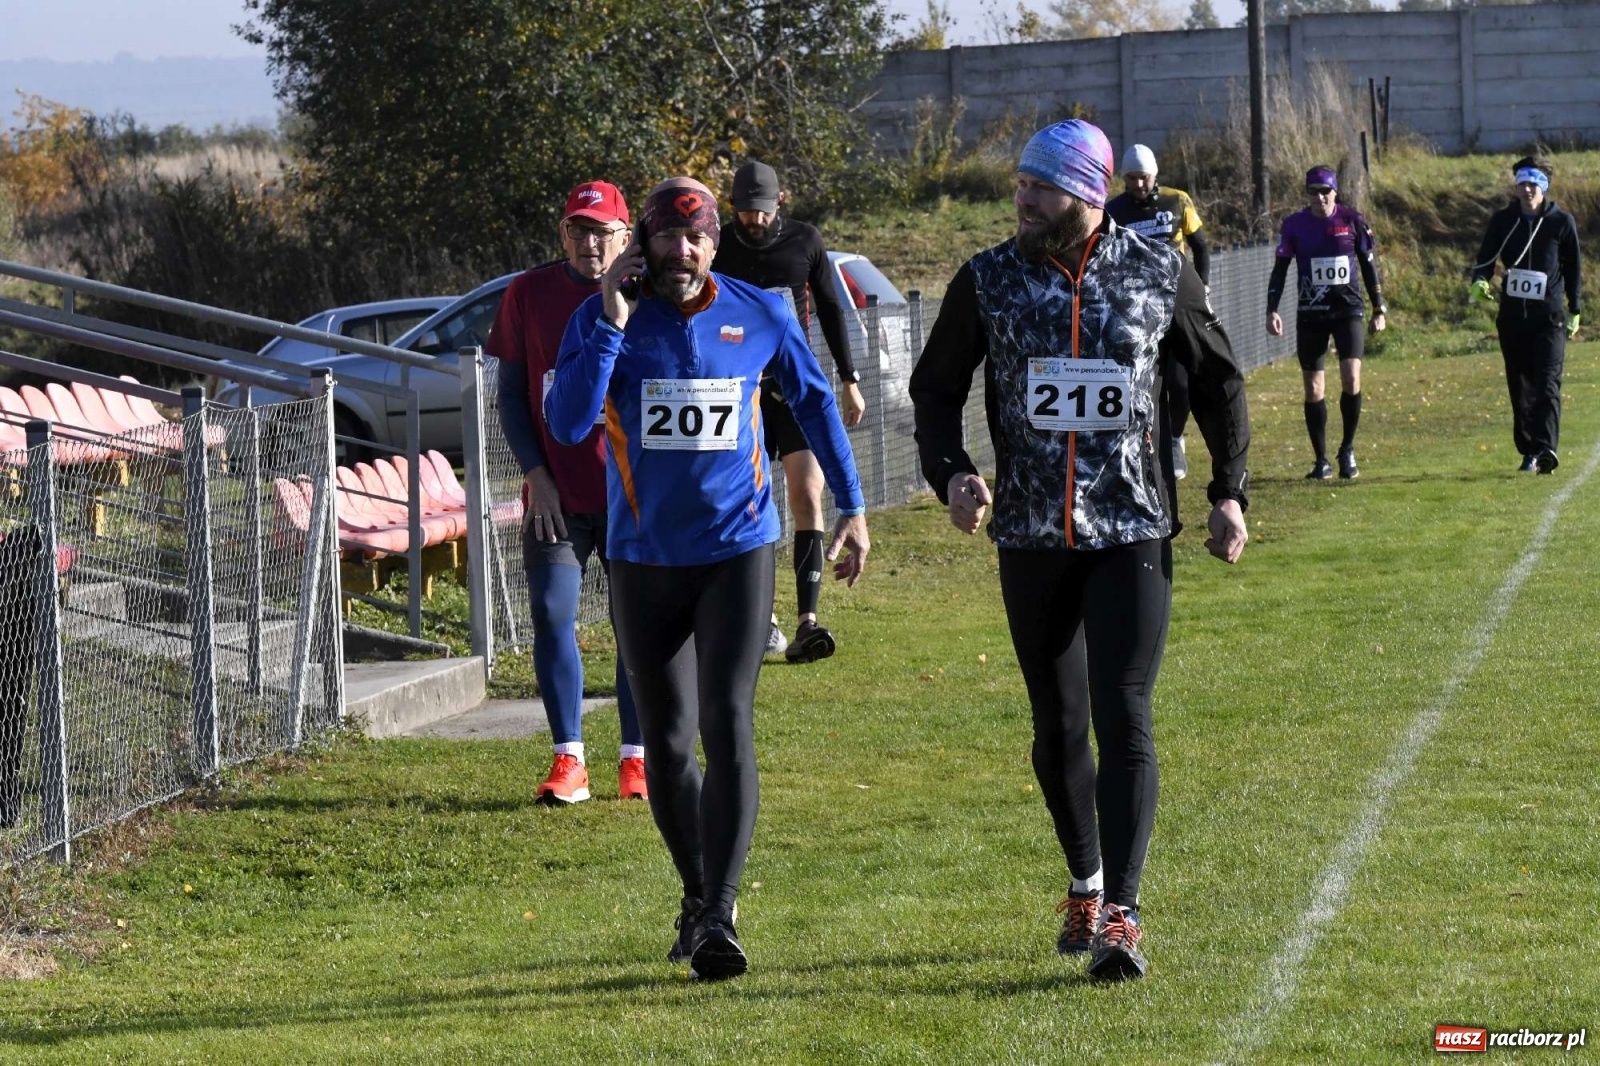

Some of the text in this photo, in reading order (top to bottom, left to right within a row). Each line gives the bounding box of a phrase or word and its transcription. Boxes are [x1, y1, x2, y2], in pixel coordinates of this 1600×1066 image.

[1315, 267, 1347, 280] 100
[1510, 279, 1542, 294] 101
[1033, 383, 1124, 418] 218
[646, 405, 733, 437] 207
